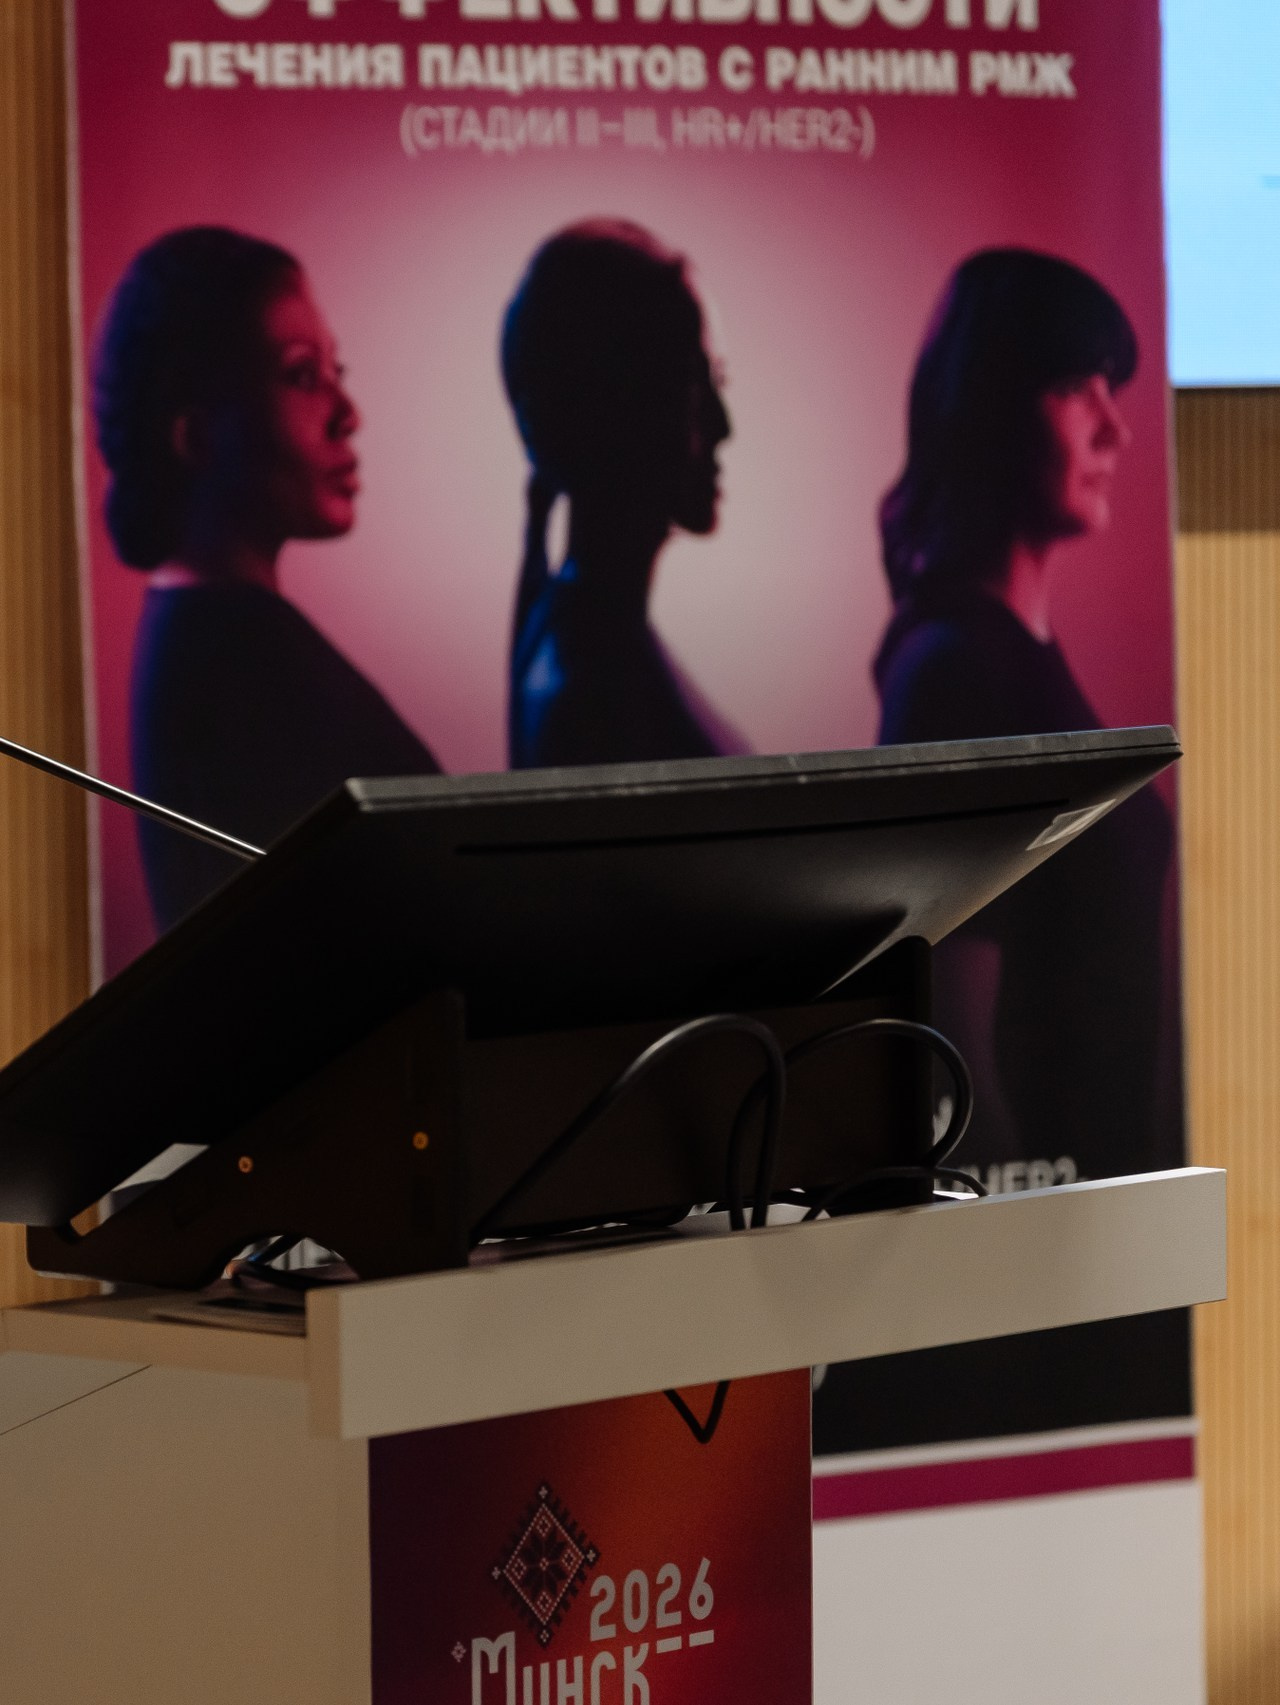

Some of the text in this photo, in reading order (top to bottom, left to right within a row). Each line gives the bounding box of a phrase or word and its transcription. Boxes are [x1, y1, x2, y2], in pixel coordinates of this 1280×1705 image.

[165, 41, 1077, 98] ЛЕЧЕНИЯ ПАЦИЕНТОВ С РАННИМ РМЖ
[400, 104, 569, 157] (СТАДИИ
[590, 1557, 714, 1642] 2026
